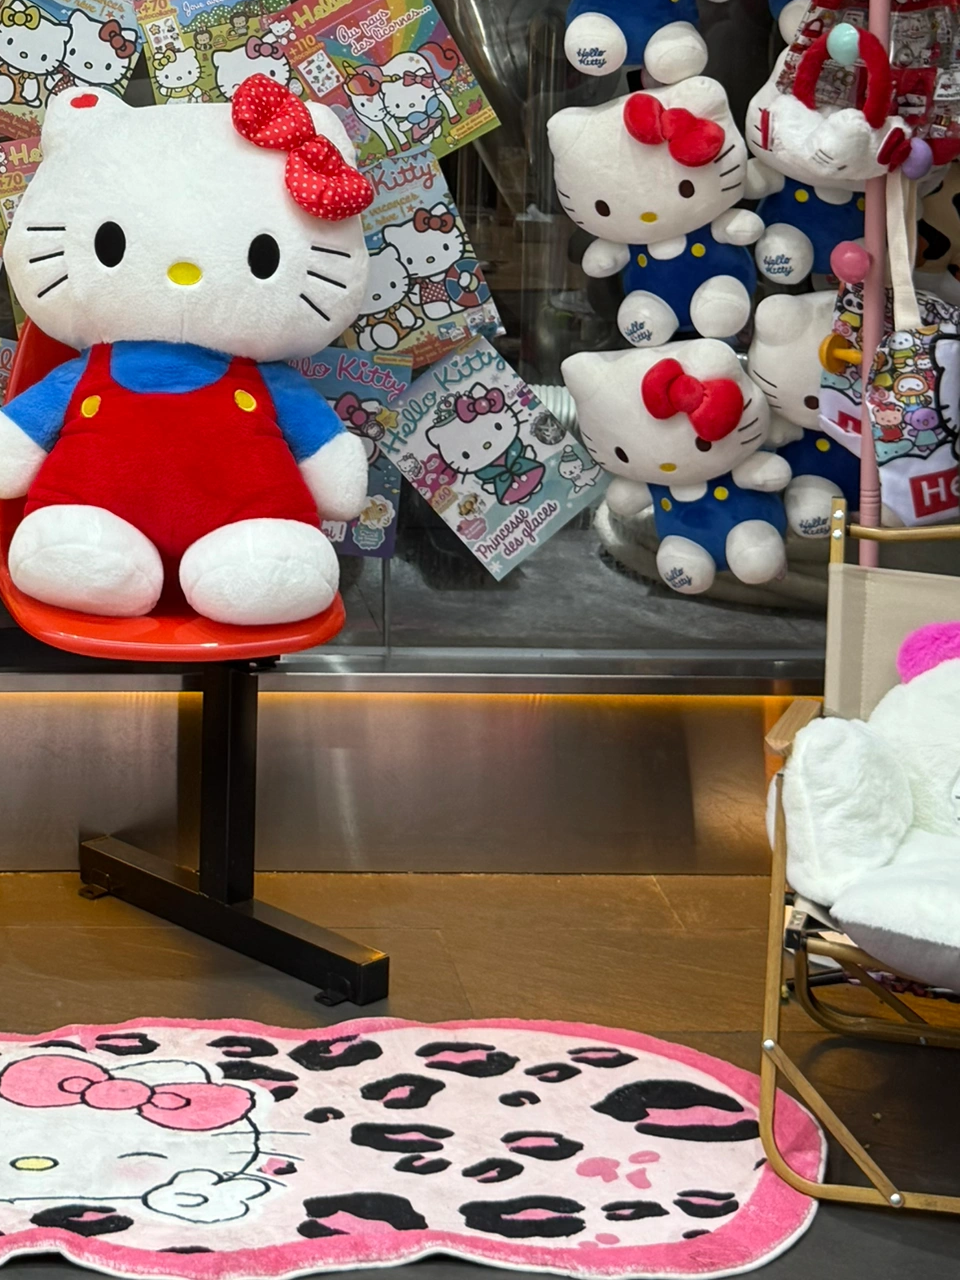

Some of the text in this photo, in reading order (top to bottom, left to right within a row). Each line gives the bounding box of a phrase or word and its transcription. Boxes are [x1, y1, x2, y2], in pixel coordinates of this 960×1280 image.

[351, 38, 373, 56] des
[576, 46, 607, 61] Hello
[578, 54, 608, 69] Kitty
[337, 352, 408, 402] Kitty
[381, 347, 508, 456] Hello Kitty
[476, 507, 531, 562] Princesse
[521, 498, 560, 543] glaces
